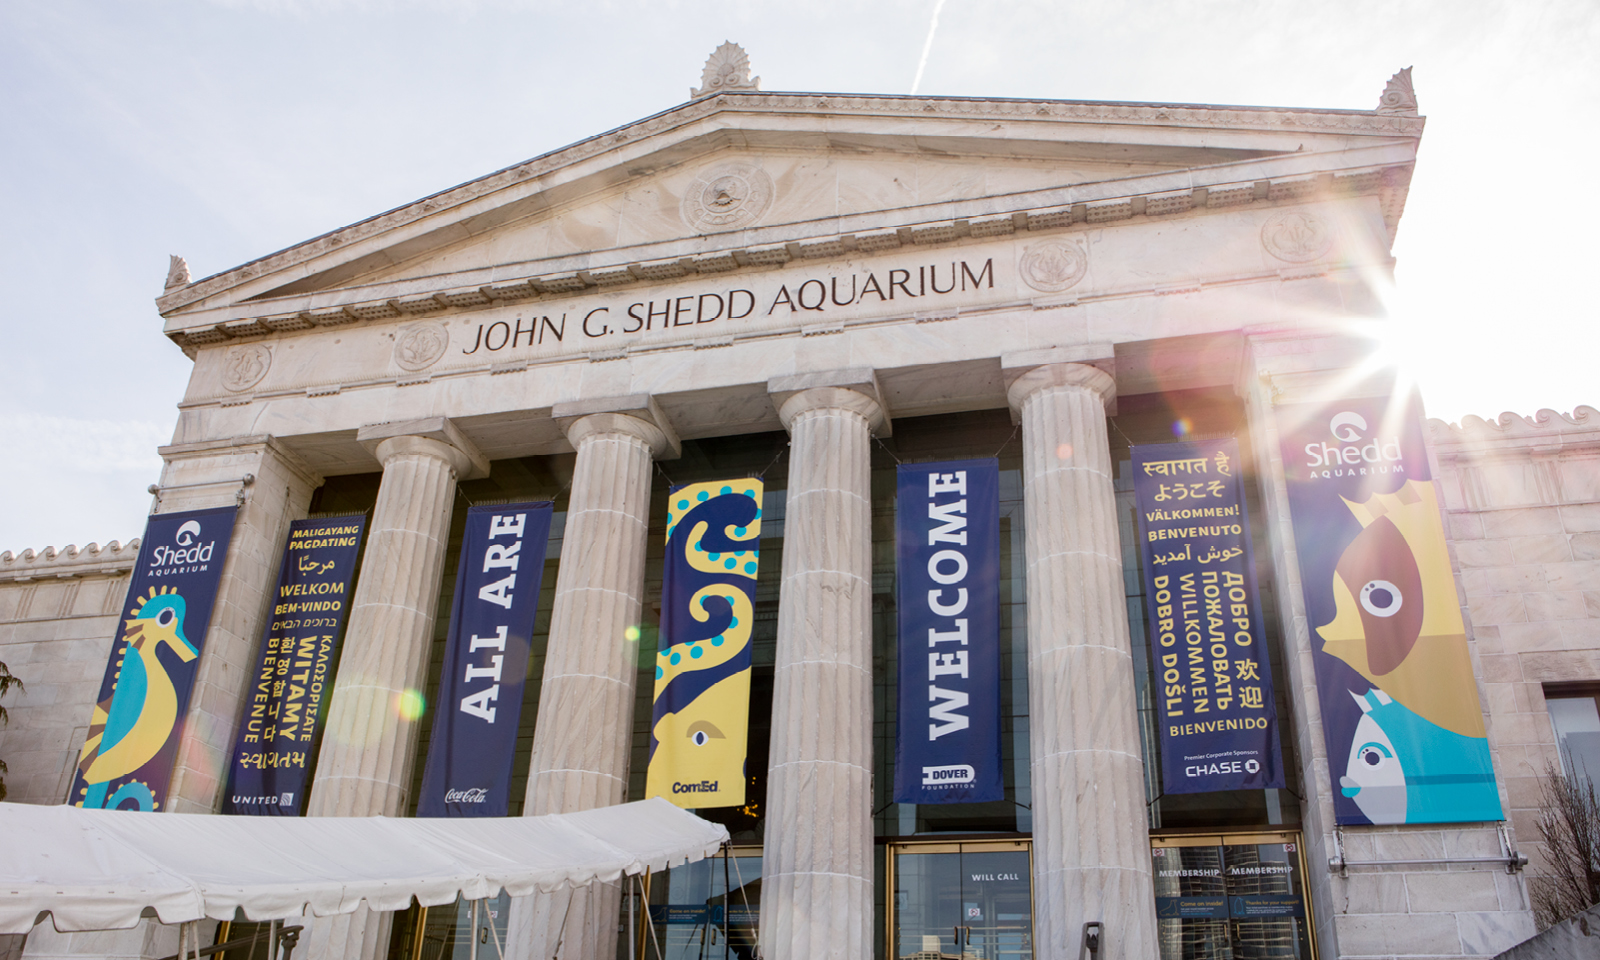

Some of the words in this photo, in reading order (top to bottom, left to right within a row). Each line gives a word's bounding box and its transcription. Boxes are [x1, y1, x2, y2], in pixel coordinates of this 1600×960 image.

[463, 313, 566, 354] JOHN
[582, 306, 614, 337] G.
[623, 288, 756, 333] SHEDD
[767, 258, 995, 316] AQUARIUM
[1304, 436, 1403, 467] Shedd
[1142, 457, 1208, 477] स्वागत
[1214, 451, 1232, 477] है
[1310, 465, 1404, 479] AQUARIUM
[1154, 480, 1226, 502] ようこそ
[1146, 504, 1240, 522] VÄLKOMMEN!
[292, 525, 360, 539] MALIGAYANG
[1148, 524, 1242, 542] BENVENUTO
[289, 536, 357, 551] PAGDATING
[150, 540, 215, 568] Shedd
[478, 512, 527, 609] ARE
[1197, 544, 1244, 564] خوش
[147, 564, 208, 577] AQUARIUM
[280, 582, 344, 598] WELKOM
[274, 600, 341, 615] BEM-VINDO
[927, 470, 970, 741] WELCOME
[1154, 575, 1176, 648] DOBRO
[1222, 571, 1252, 647] ДОБРО
[271, 619, 301, 631] הבאים
[302, 618, 337, 628] ברוכים
[1179, 572, 1210, 714] WILLKOMMEN
[1201, 571, 1233, 711] ПОЖАЛОВАТЬ
[460, 624, 508, 724] ALL
[244, 638, 280, 743] BIENVENUE
[279, 635, 318, 741] WITAMY
[1162, 653, 1187, 717] DOŠLI
[1234, 658, 1264, 709] 欢迎
[1169, 717, 1268, 737] BIENVENIDO
[1206, 751, 1233, 759] Corporate
[932, 769, 968, 780] DOVER
[1185, 761, 1243, 777] CHASE
[445, 788, 489, 804] Coca-Cola
[672, 780, 719, 794] ComEd
[921, 783, 975, 791] FOUNDATION
[231, 795, 278, 805] UNITED
[997, 873, 1019, 881] CALL
[1159, 869, 1220, 878] MEMBERSHIP
[1231, 866, 1294, 876] MEMBERSHIP
